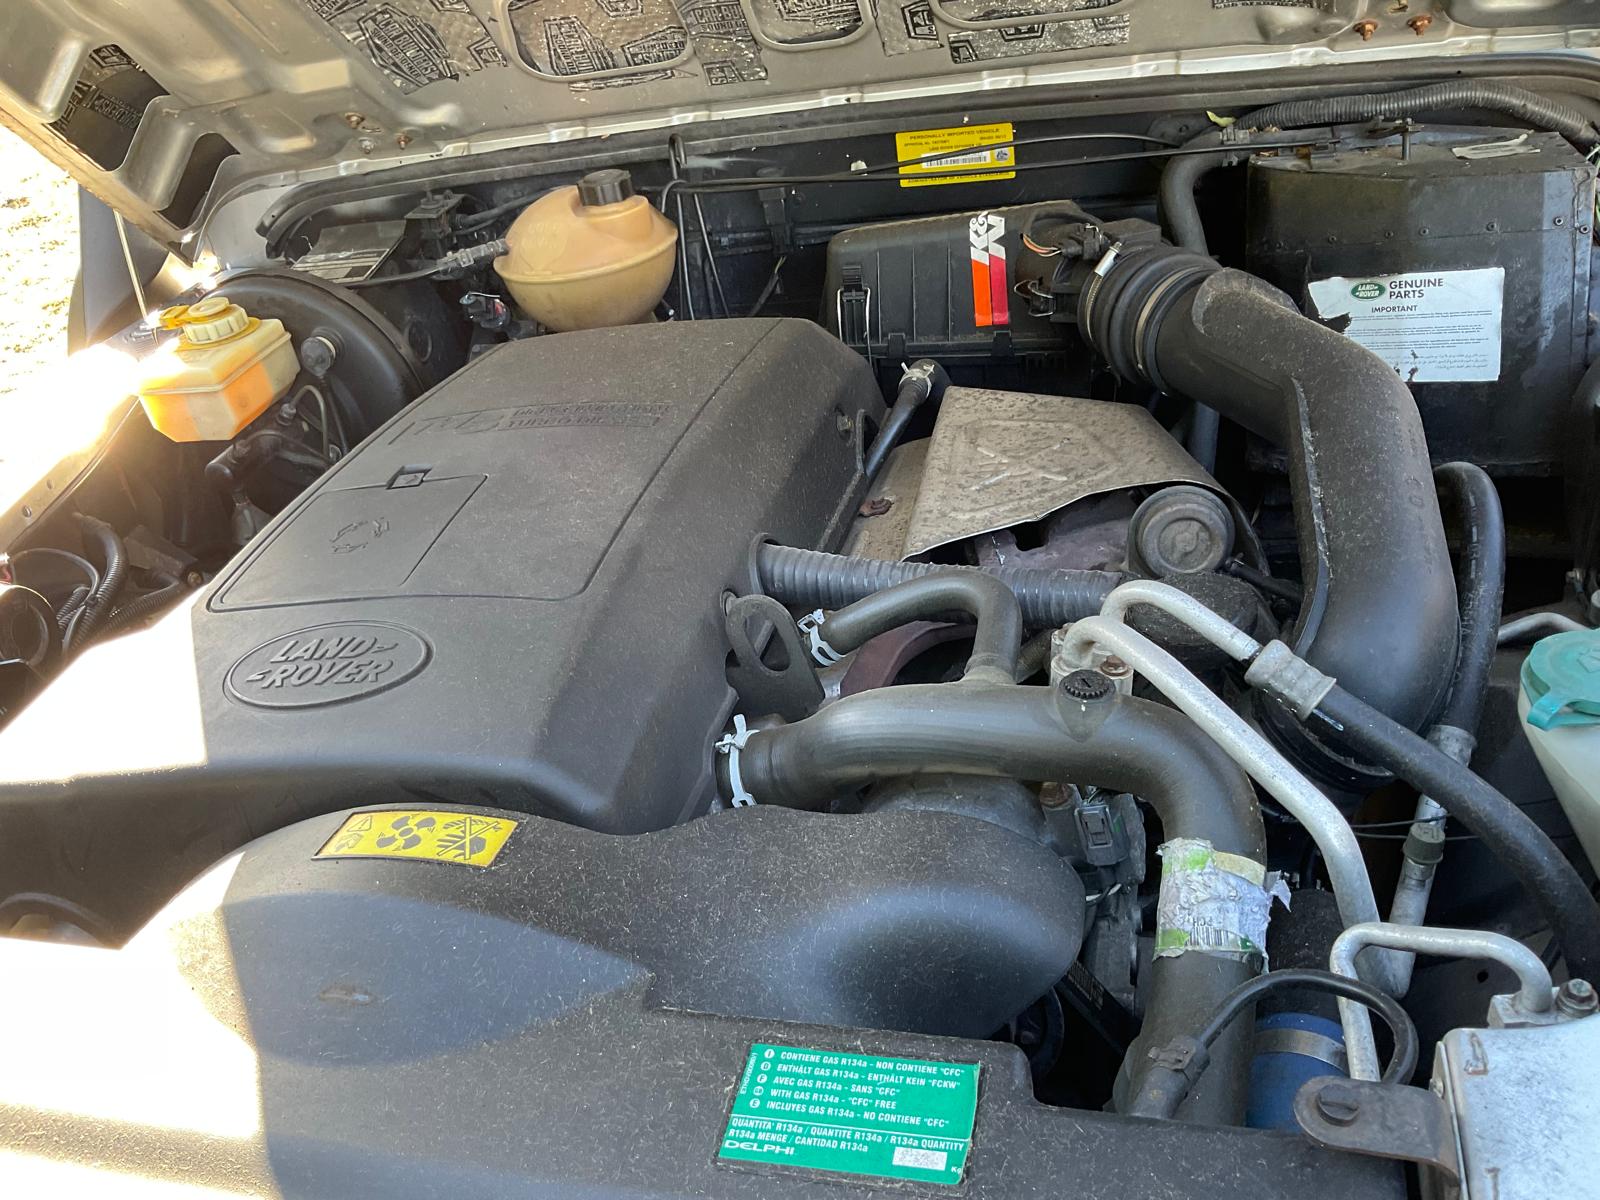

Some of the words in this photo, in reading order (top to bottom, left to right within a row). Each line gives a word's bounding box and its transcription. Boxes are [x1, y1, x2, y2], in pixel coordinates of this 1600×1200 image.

[1389, 278, 1444, 290] GENUINE
[1389, 289, 1424, 299] PARTS
[1371, 305, 1418, 313] IMPORTANT
[270, 636, 378, 664] LAND
[261, 660, 394, 690] ROVER
[780, 1051, 821, 1063] CONTIENE
[823, 1056, 839, 1065] GAS
[841, 1056, 867, 1068] R134a
[876, 1061, 894, 1070] NON
[896, 1063, 938, 1074] CONTIENE
[940, 1067, 965, 1077] "CFC"
[773, 1076, 795, 1086] AVEC
[797, 1079, 813, 1088] GAS
[815, 1080, 842, 1090] R134a
[850, 1084, 873, 1094] SANS
[875, 1087, 900, 1096] "CFC"
[814, 1067, 830, 1077] GAS
[832, 1068, 859, 1080] R134a
[905, 1077, 926, 1086] KEIN
[928, 1079, 961, 1089] "FCKW"
[770, 1088, 792, 1099] WITH
[793, 1091, 810, 1100] GAS
[812, 1093, 839, 1103] R134a
[848, 1097, 873, 1106] "CFC"
[874, 1100, 897, 1109] FREE
[766, 1101, 806, 1112] INCLUYES
[808, 1105, 825, 1114] GAS
[827, 1106, 855, 1118] R134a
[863, 1111, 876, 1120] NO
[878, 1113, 921, 1125] CONTIENE
[923, 1118, 950, 1128] "CFC"
[724, 1139, 795, 1156] DELPHI
[728, 1128, 755, 1140] R134a
[757, 1131, 788, 1144] MENGE
[795, 1136, 838, 1149] CANTIDAD
[839, 1140, 869, 1153] R134a
[775, 1122, 804, 1134] R134a
[854, 1131, 883, 1143] R134a
[890, 1135, 919, 1147] R134a
[921, 1139, 965, 1152] QUANTITY
